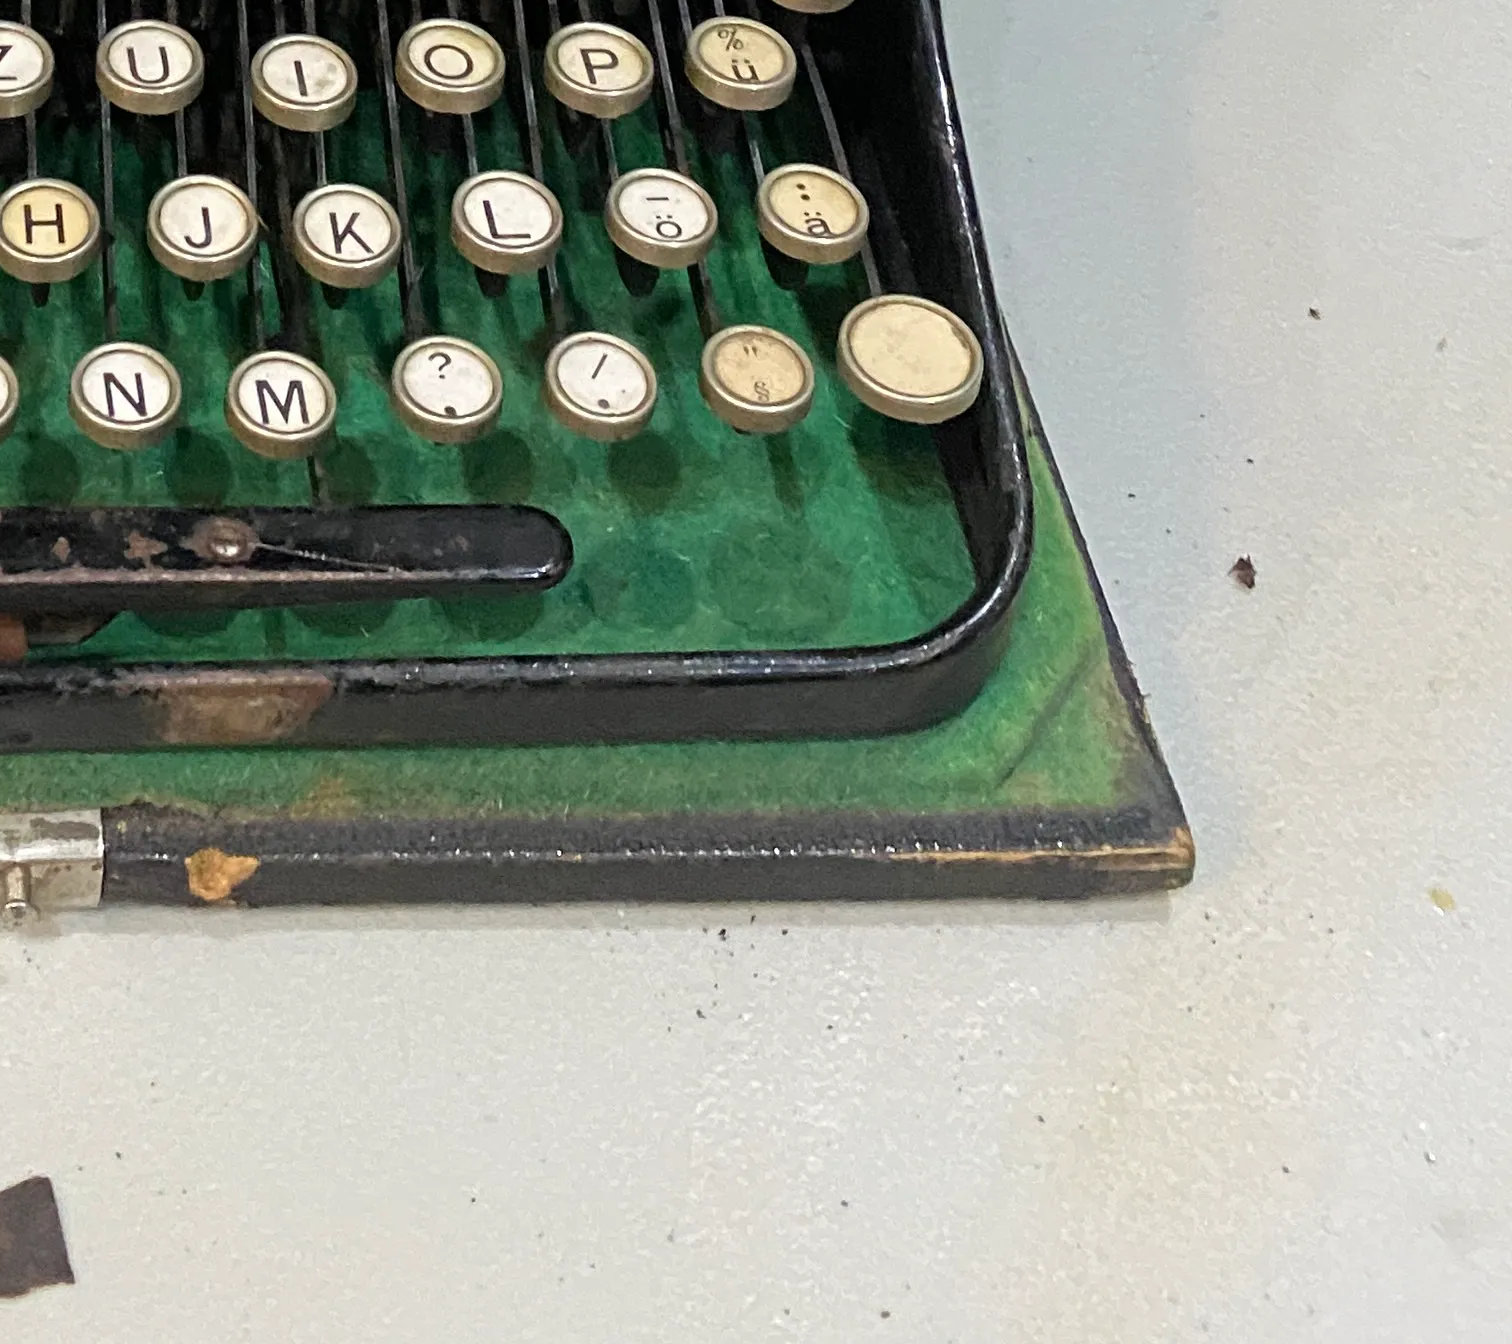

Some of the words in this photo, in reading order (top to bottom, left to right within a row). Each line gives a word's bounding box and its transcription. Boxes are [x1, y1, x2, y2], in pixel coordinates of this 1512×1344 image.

[127, 46, 170, 84] U
[423, 44, 474, 80] O
[579, 47, 619, 85] P
[23, 202, 65, 246] H
[182, 205, 212, 249] J
[328, 211, 375, 255] K
[481, 199, 532, 239] L
[102, 371, 148, 418] N
[255, 379, 311, 425] M
